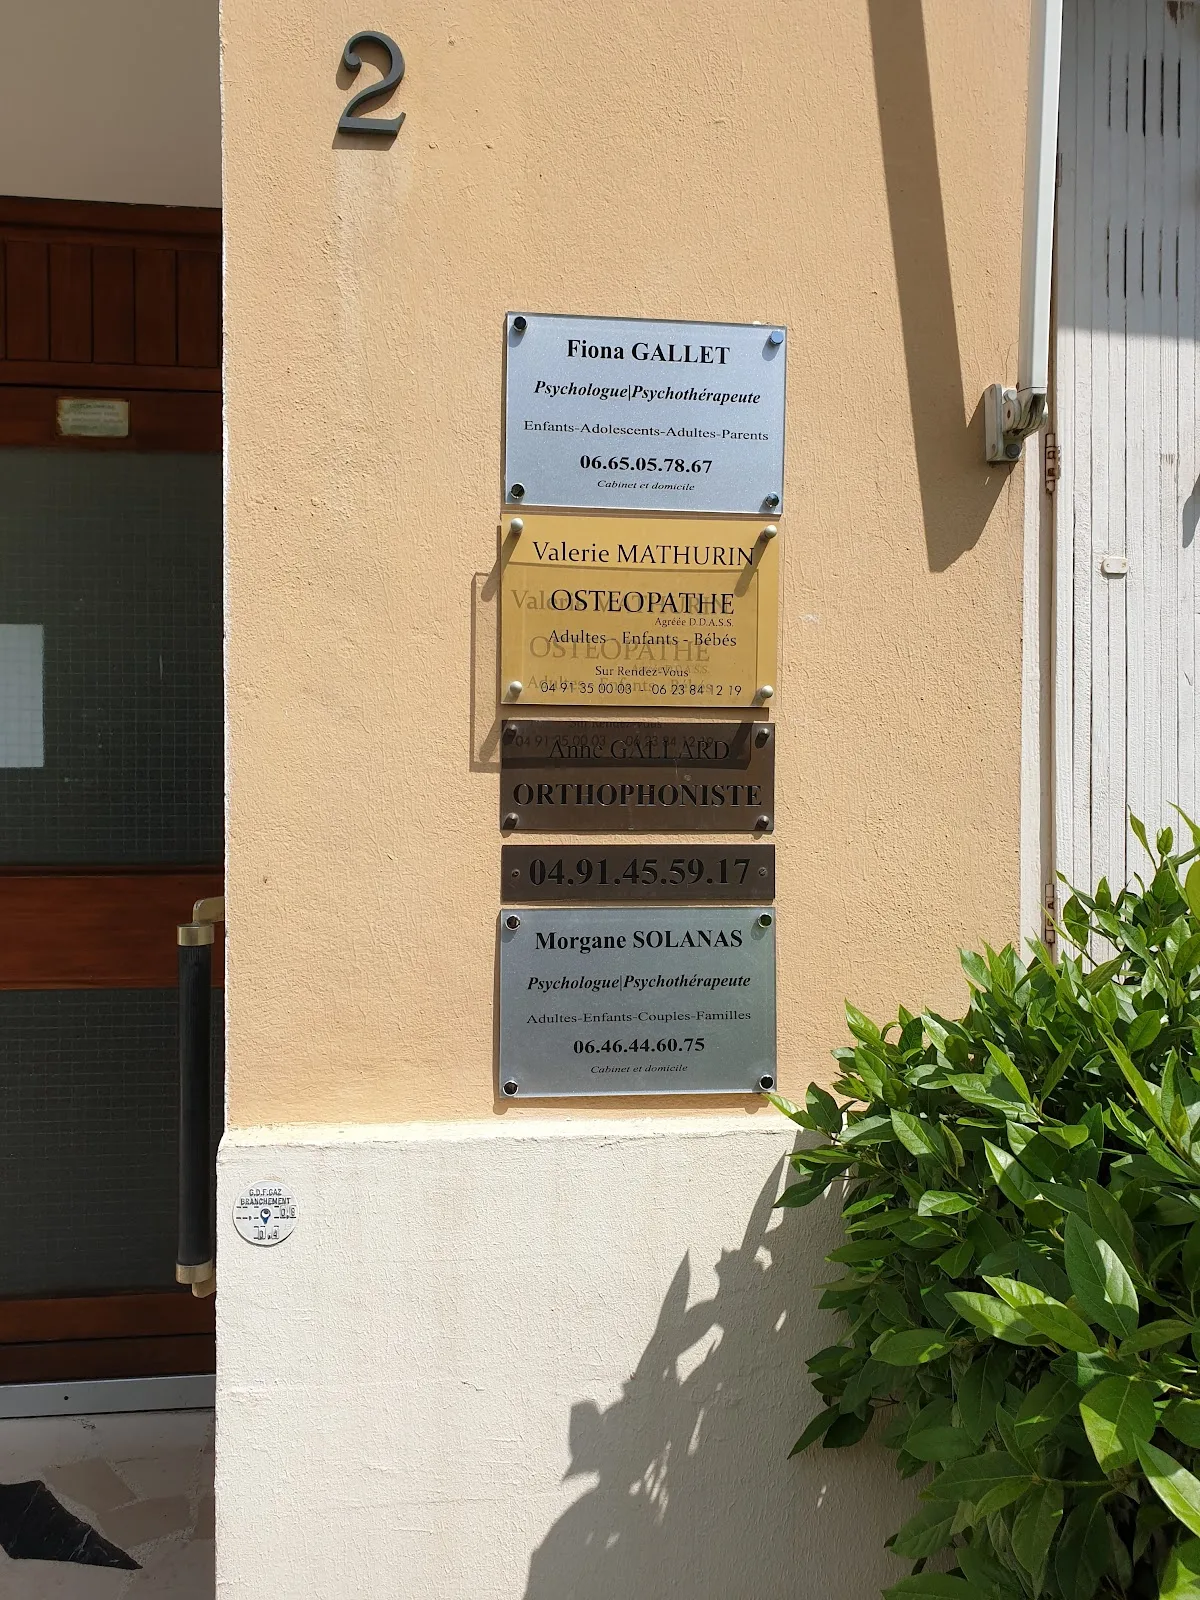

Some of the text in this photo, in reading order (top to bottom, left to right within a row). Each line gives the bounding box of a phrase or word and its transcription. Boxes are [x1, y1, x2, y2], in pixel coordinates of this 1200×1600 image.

[338, 30, 407, 136] 2
[567, 339, 731, 364] Fiona GALLET
[524, 420, 769, 441] Enfants-Adolescents-Adultes-Parents
[580, 455, 713, 474] 06.65.05.78.67
[597, 479, 638, 490] Cabinet
[651, 482, 695, 491] domicile
[533, 541, 755, 566] Valerie MATHURIN
[551, 589, 735, 615] OSTEOPATHE
[548, 630, 607, 644] Adultes
[622, 631, 679, 645] Enfants
[694, 632, 737, 646] Bébés
[595, 665, 689, 677] Sur Rendez-Vous
[540, 682, 556, 693] 04
[560, 682, 574, 693] 91
[579, 682, 594, 693] 35
[598, 683, 614, 694] 00
[617, 683, 632, 694] 03
[651, 684, 667, 695] 06
[671, 684, 685, 695] 23
[690, 684, 704, 695] 84
[710, 685, 723, 696] 12
[728, 685, 742, 696] 19
[549, 739, 730, 760] Anne GALLARD
[513, 783, 763, 807] ORTHOPHONISTE
[529, 858, 751, 886] 04.91.45.59.17
[535, 929, 743, 954] Morgane SOLANAS
[526, 1010, 752, 1024] Adultes-Enfants-Couples-Familles
[573, 1038, 705, 1054] 06.46.44.60.75
[590, 1065, 631, 1074] Cabinet
[644, 1064, 688, 1072] domicile
[240, 1197, 291, 1205] BRANCHEMENT
